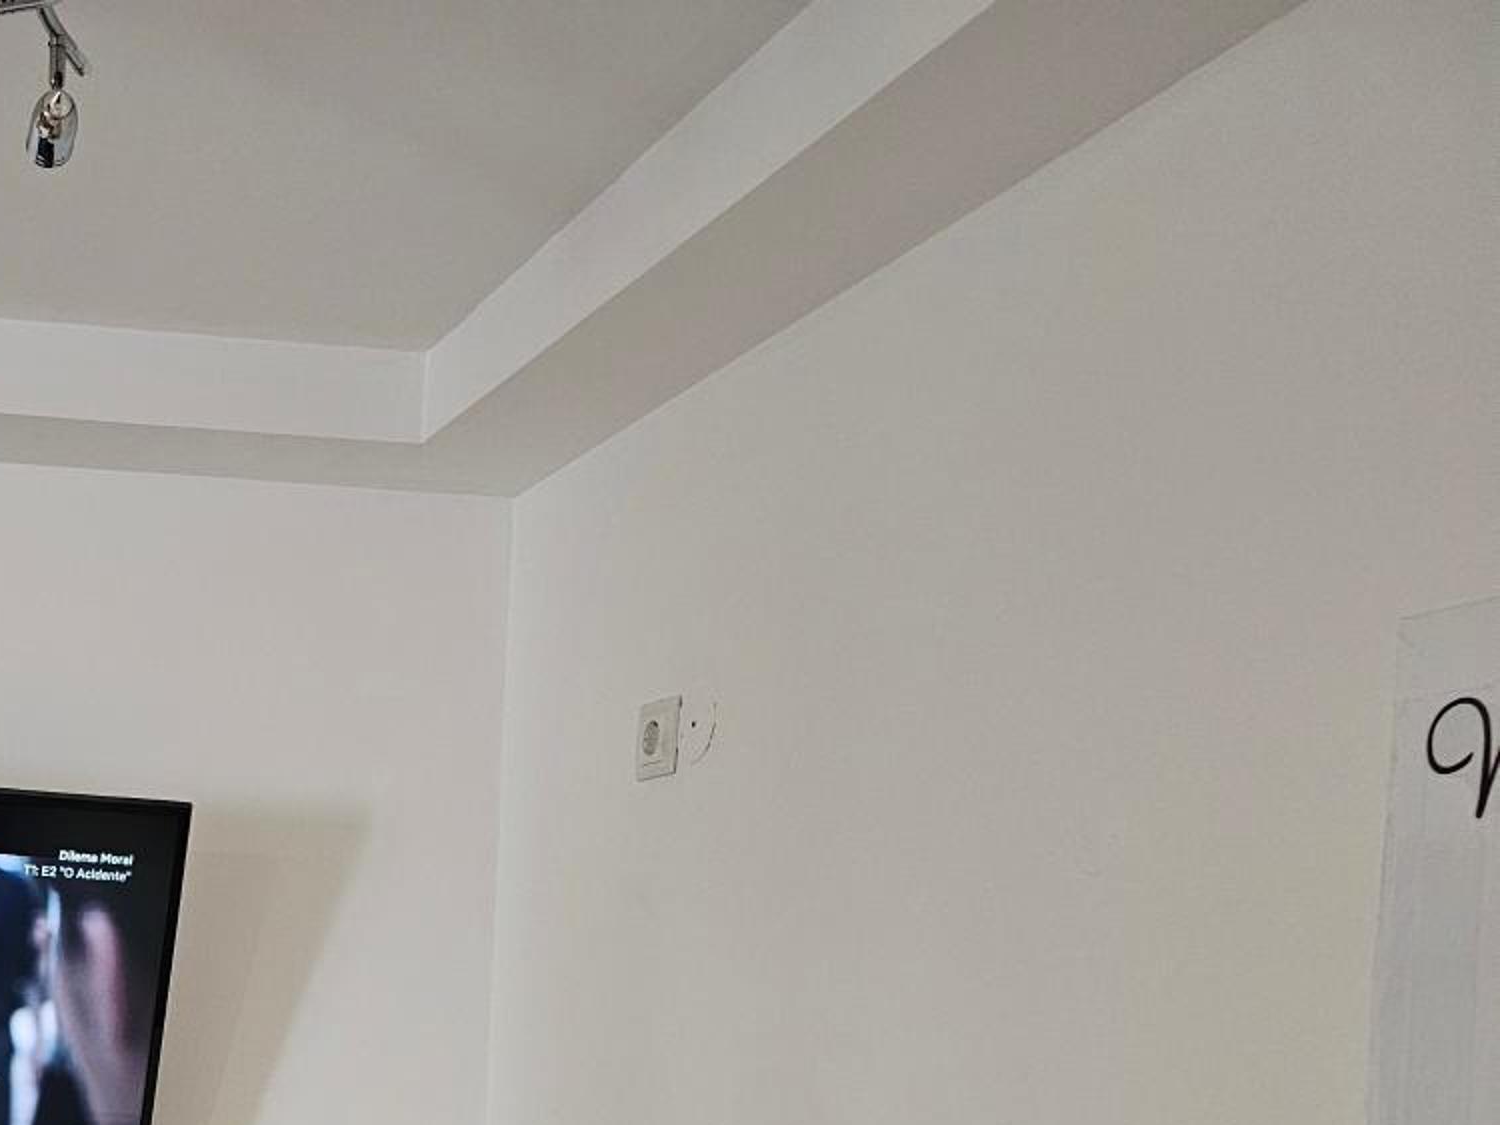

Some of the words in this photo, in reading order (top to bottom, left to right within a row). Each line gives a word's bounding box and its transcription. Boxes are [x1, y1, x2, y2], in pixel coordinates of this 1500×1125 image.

[59, 849, 99, 863] Dilema
[100, 852, 133, 866] Moral
[41, 866, 57, 878] E2
